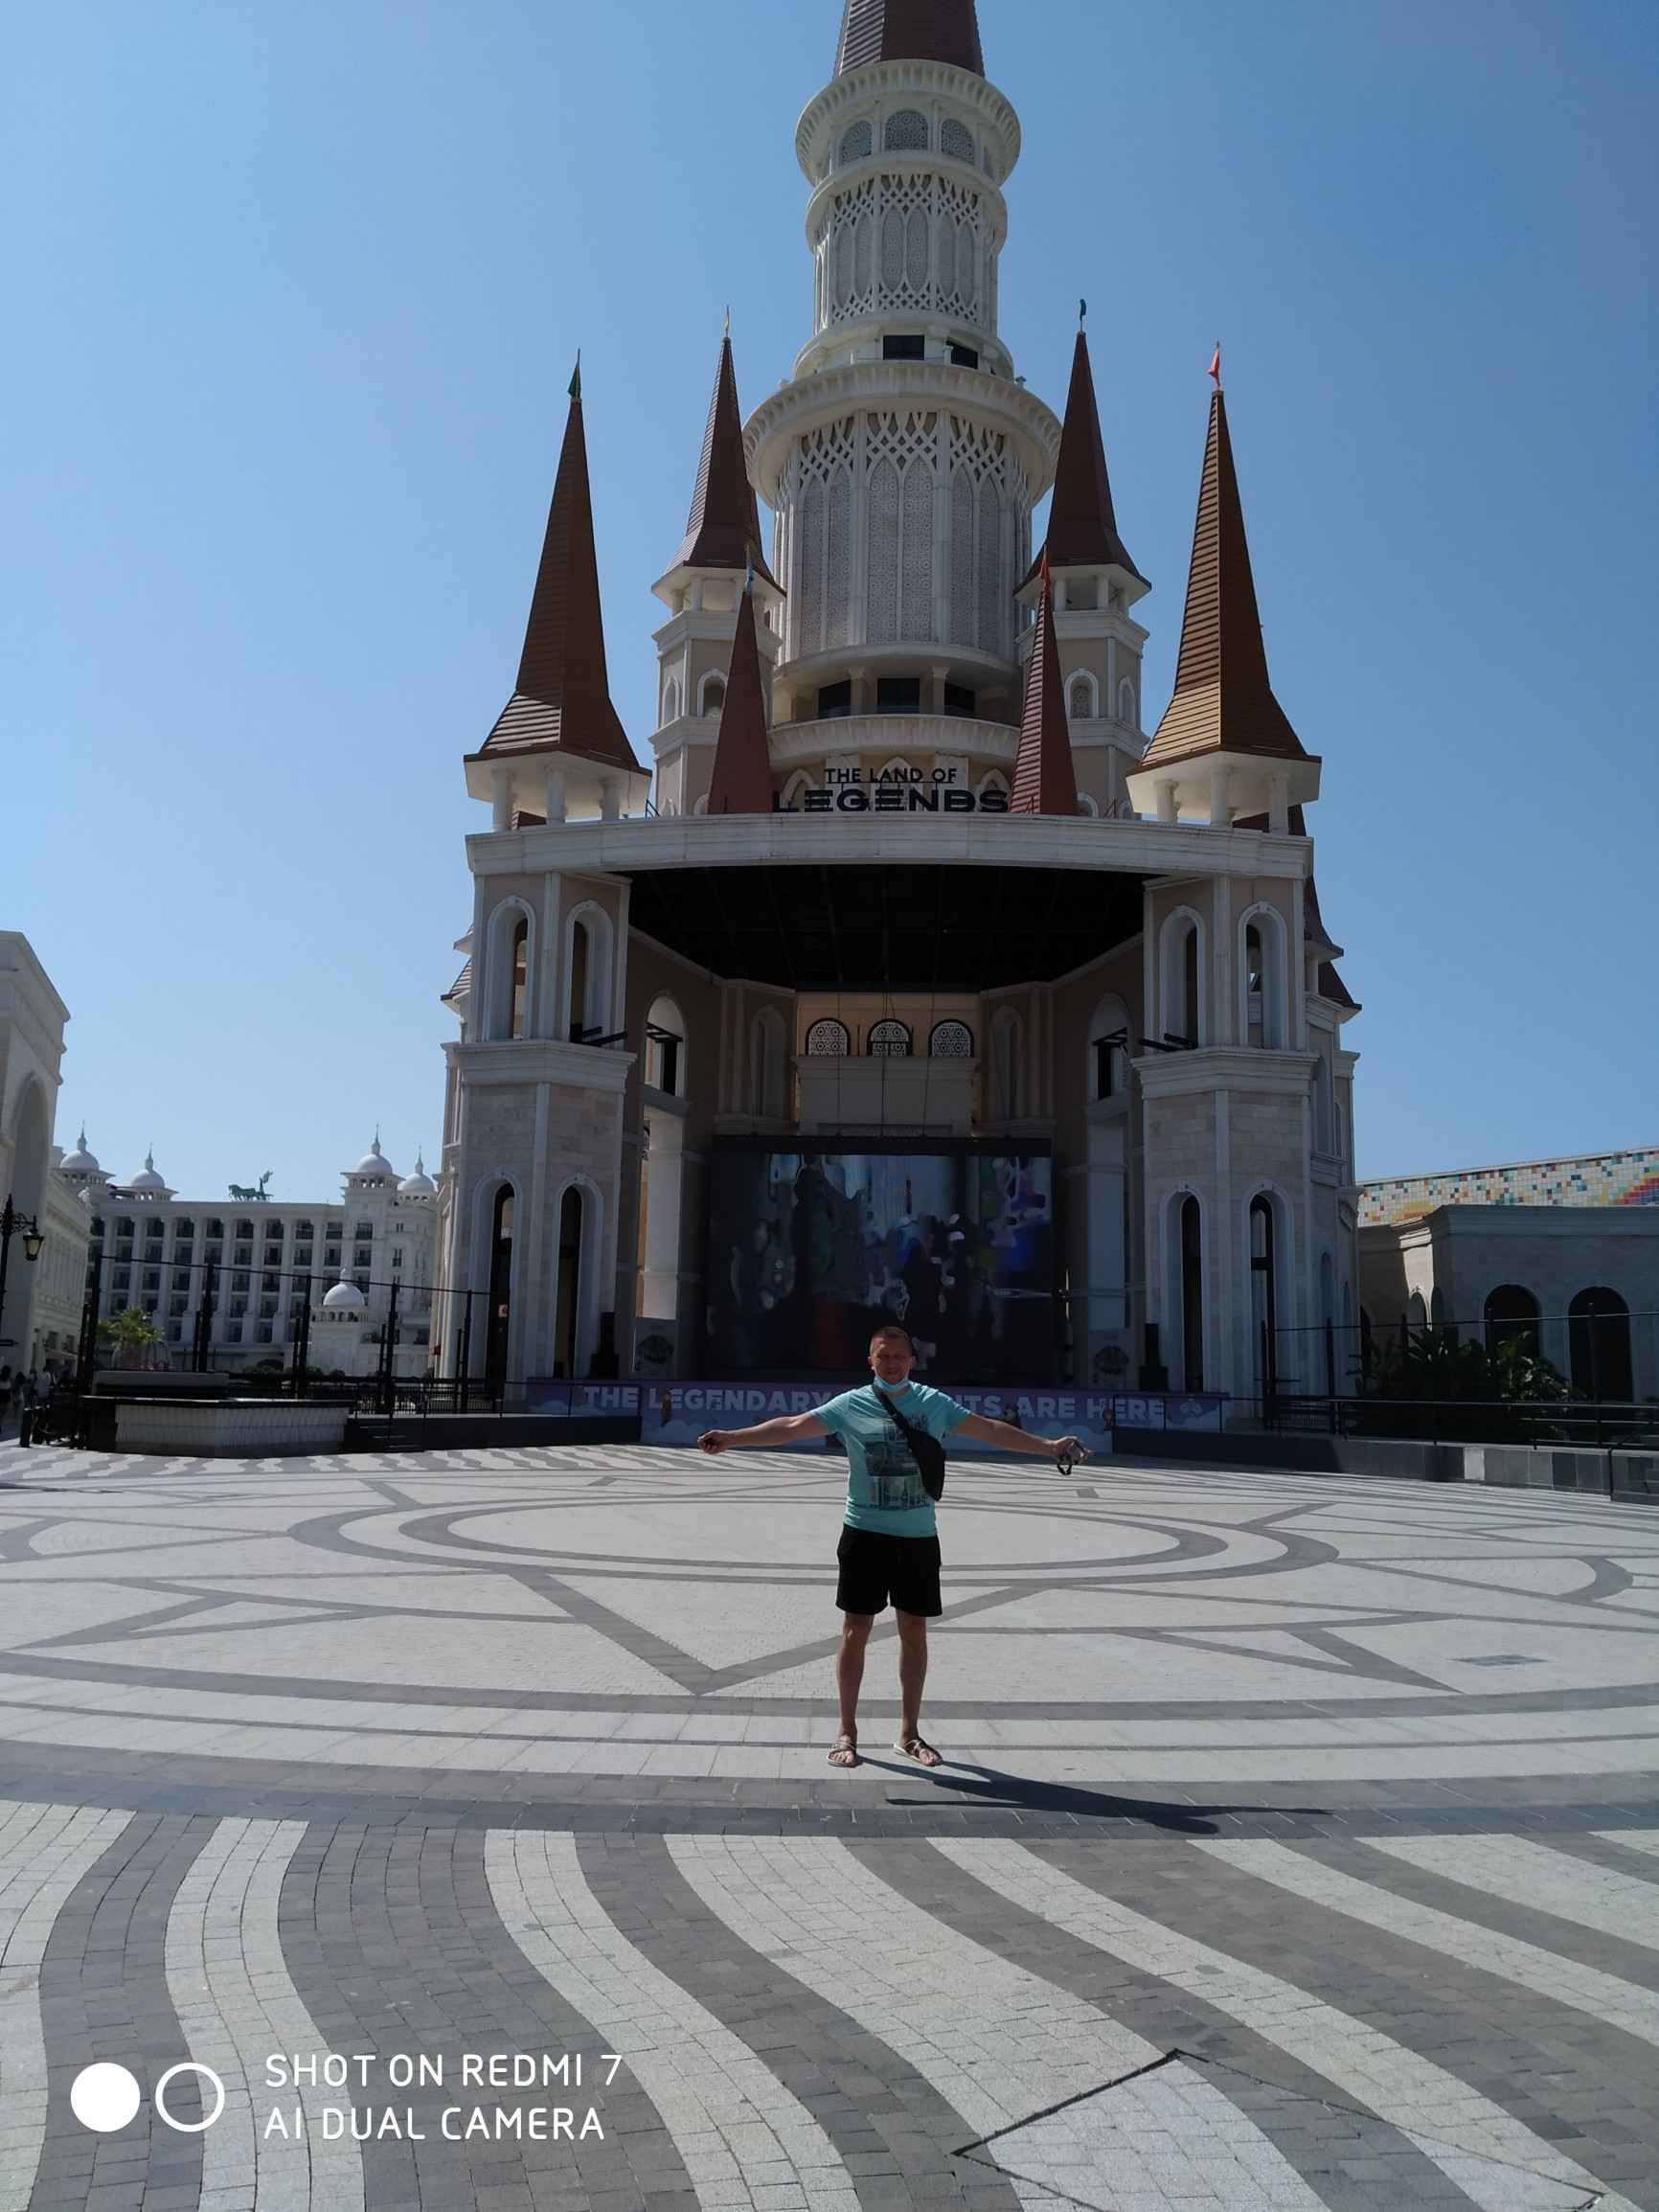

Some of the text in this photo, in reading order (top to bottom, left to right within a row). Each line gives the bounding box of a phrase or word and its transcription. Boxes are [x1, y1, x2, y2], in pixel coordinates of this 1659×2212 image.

[825, 768, 957, 783] THE LAND OF
[772, 789, 1009, 813] LEGENDS
[583, 1386, 639, 1408] THE
[648, 1387, 831, 1412] LEGENDARY
[1016, 1396, 1076, 1419] ARE
[1086, 1397, 1165, 1421] HERE
